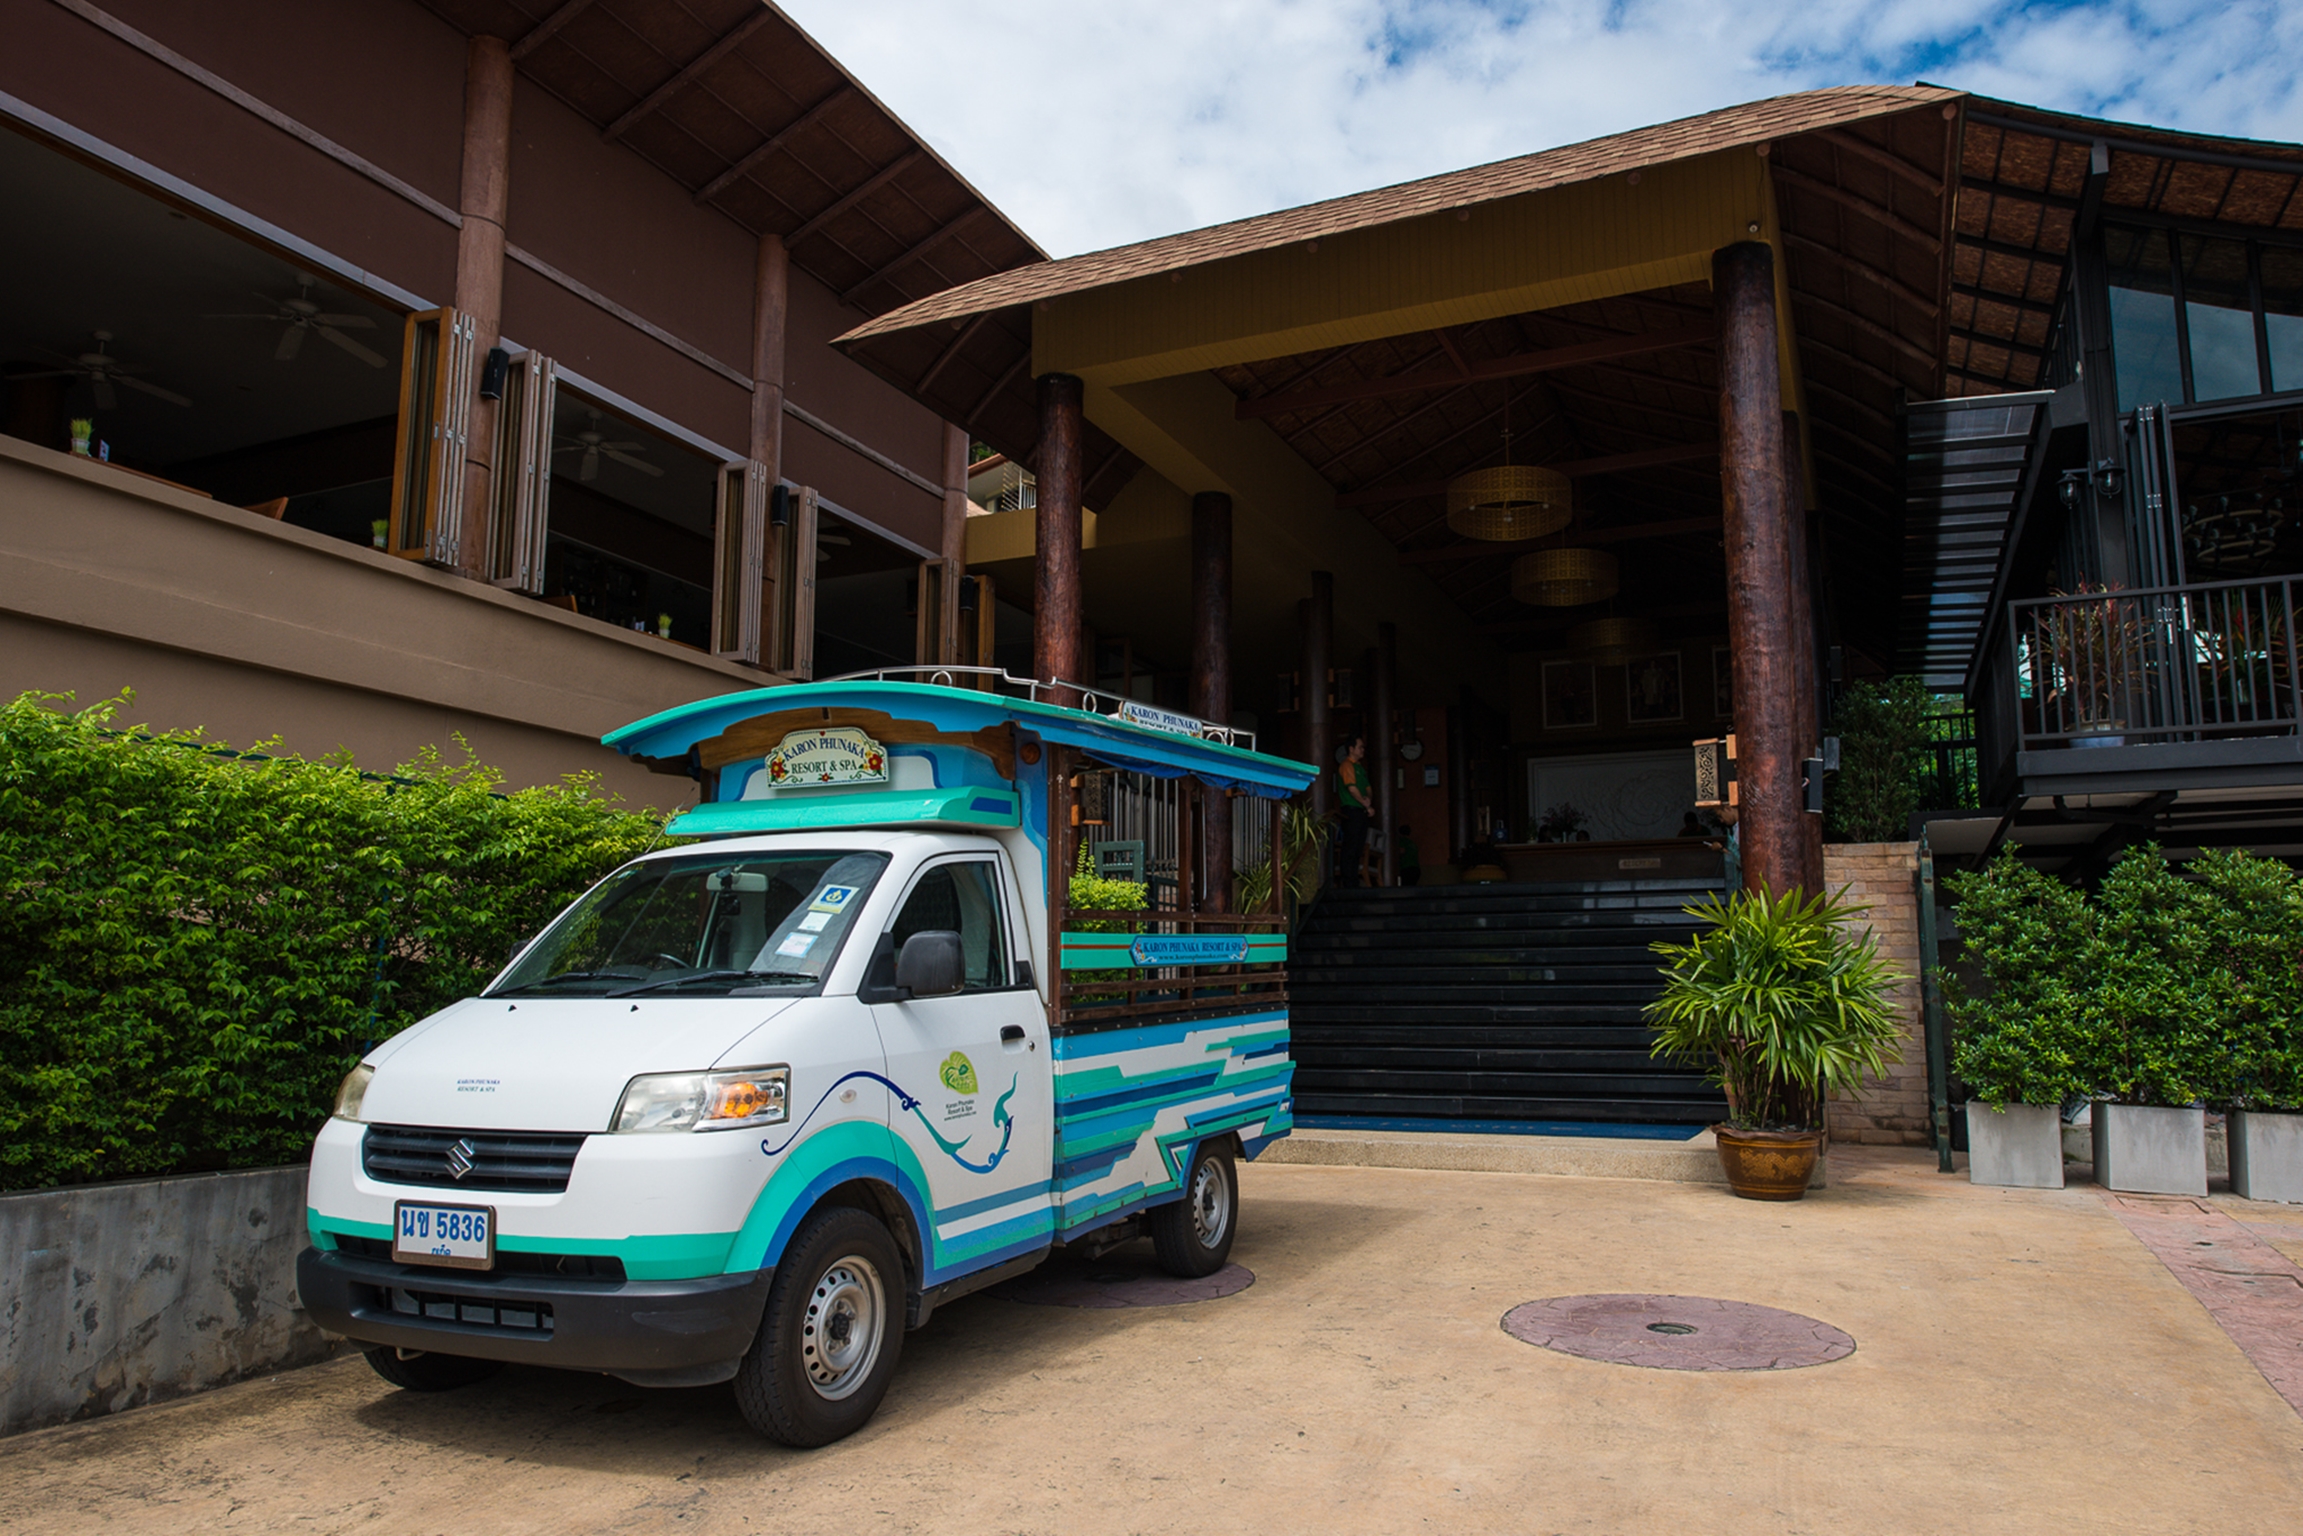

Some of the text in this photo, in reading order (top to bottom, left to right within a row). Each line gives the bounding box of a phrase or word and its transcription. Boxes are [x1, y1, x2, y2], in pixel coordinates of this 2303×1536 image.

[1131, 706, 1199, 731] KARON PHUNAKA
[783, 737, 865, 761] KARON PHUNAKA
[791, 759, 858, 774] RESORT & SPA
[1143, 942, 1168, 952] KARON
[1169, 942, 1200, 952] PHUNAKA
[1202, 942, 1225, 951] RESORT
[1225, 942, 1230, 951] &
[436, 1212, 485, 1242] 5836
